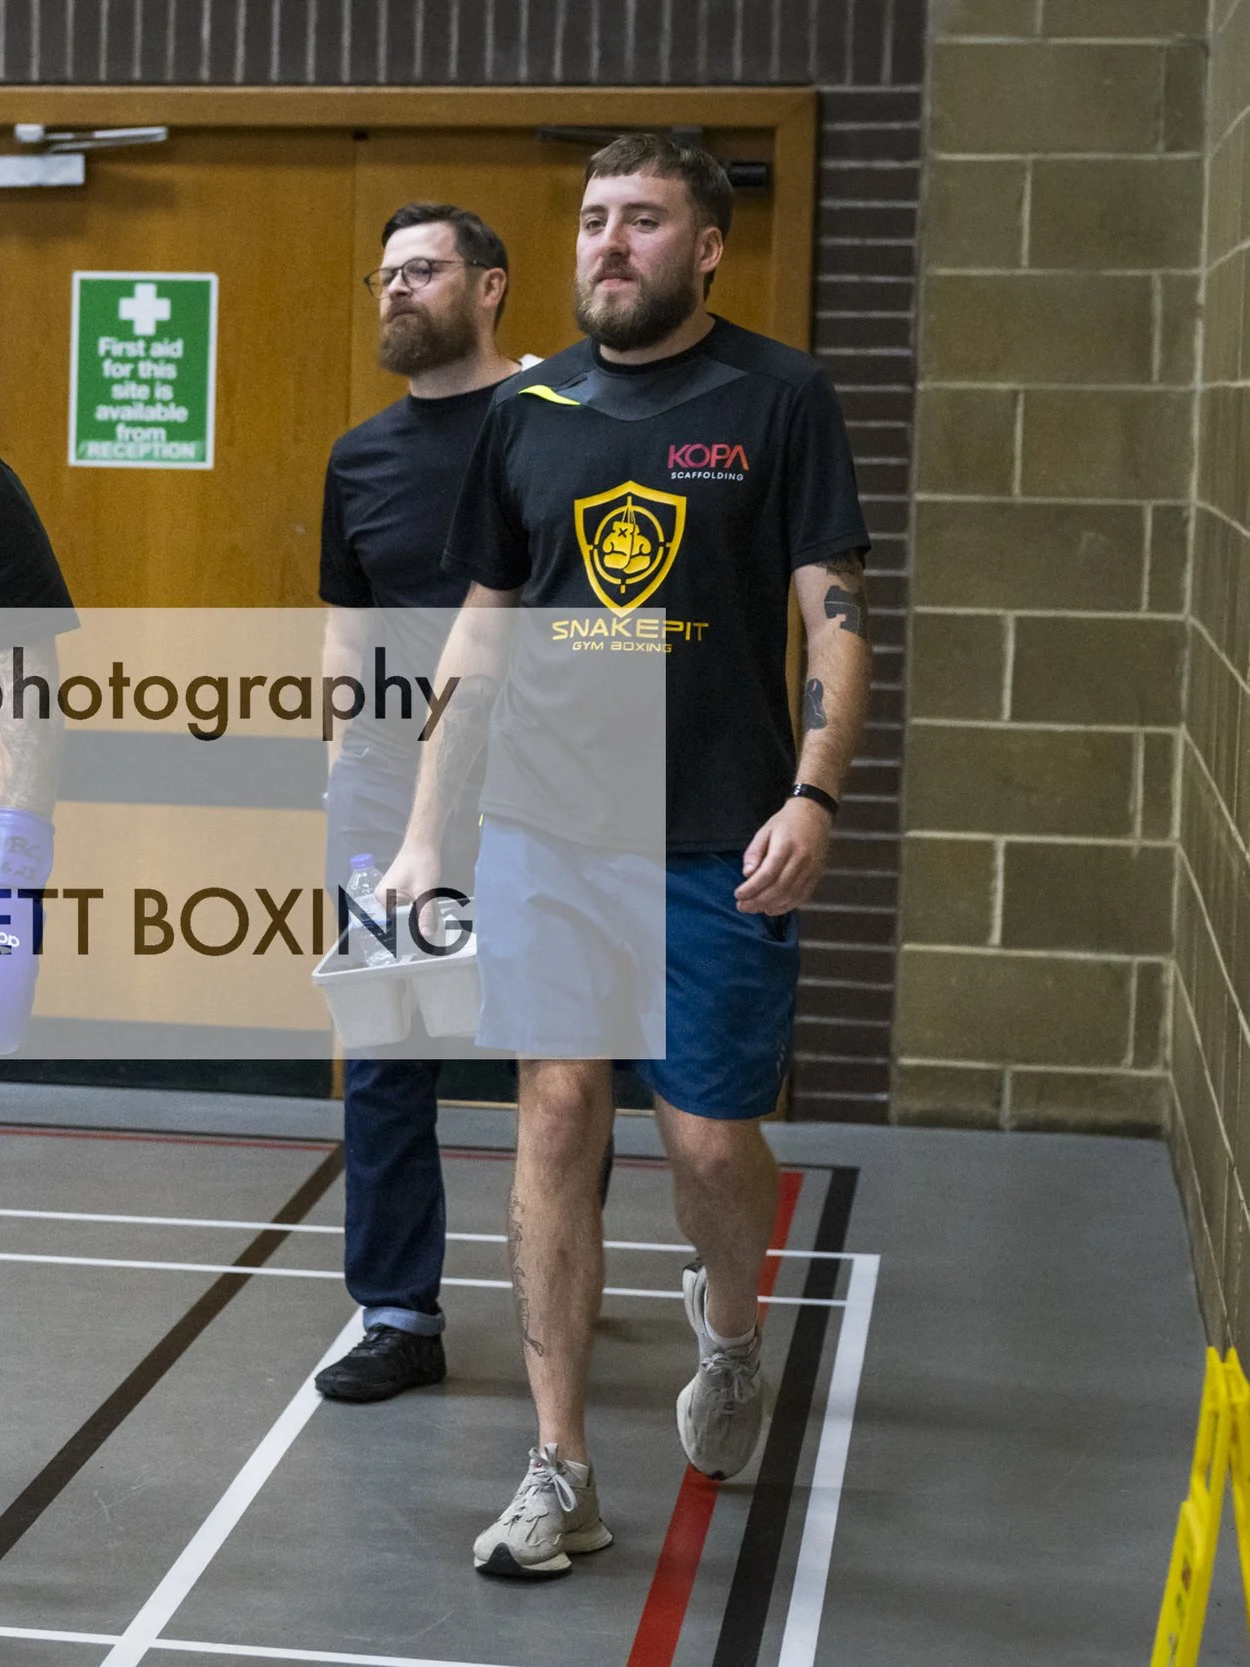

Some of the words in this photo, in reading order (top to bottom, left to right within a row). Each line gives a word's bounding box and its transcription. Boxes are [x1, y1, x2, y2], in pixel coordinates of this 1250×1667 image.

[97, 336, 146, 358] First
[149, 337, 184, 359] aid
[102, 358, 133, 379] for
[137, 360, 177, 380] this
[111, 380, 150, 401] site
[154, 381, 174, 401] is
[95, 402, 189, 423] available
[116, 422, 166, 443] from
[86, 442, 196, 460] RECEPTION
[670, 471, 744, 482] SCAFFOLDING
[551, 617, 710, 641] SNAKEPIT
[571, 640, 605, 651] GYM
[610, 640, 673, 653] BOXING
